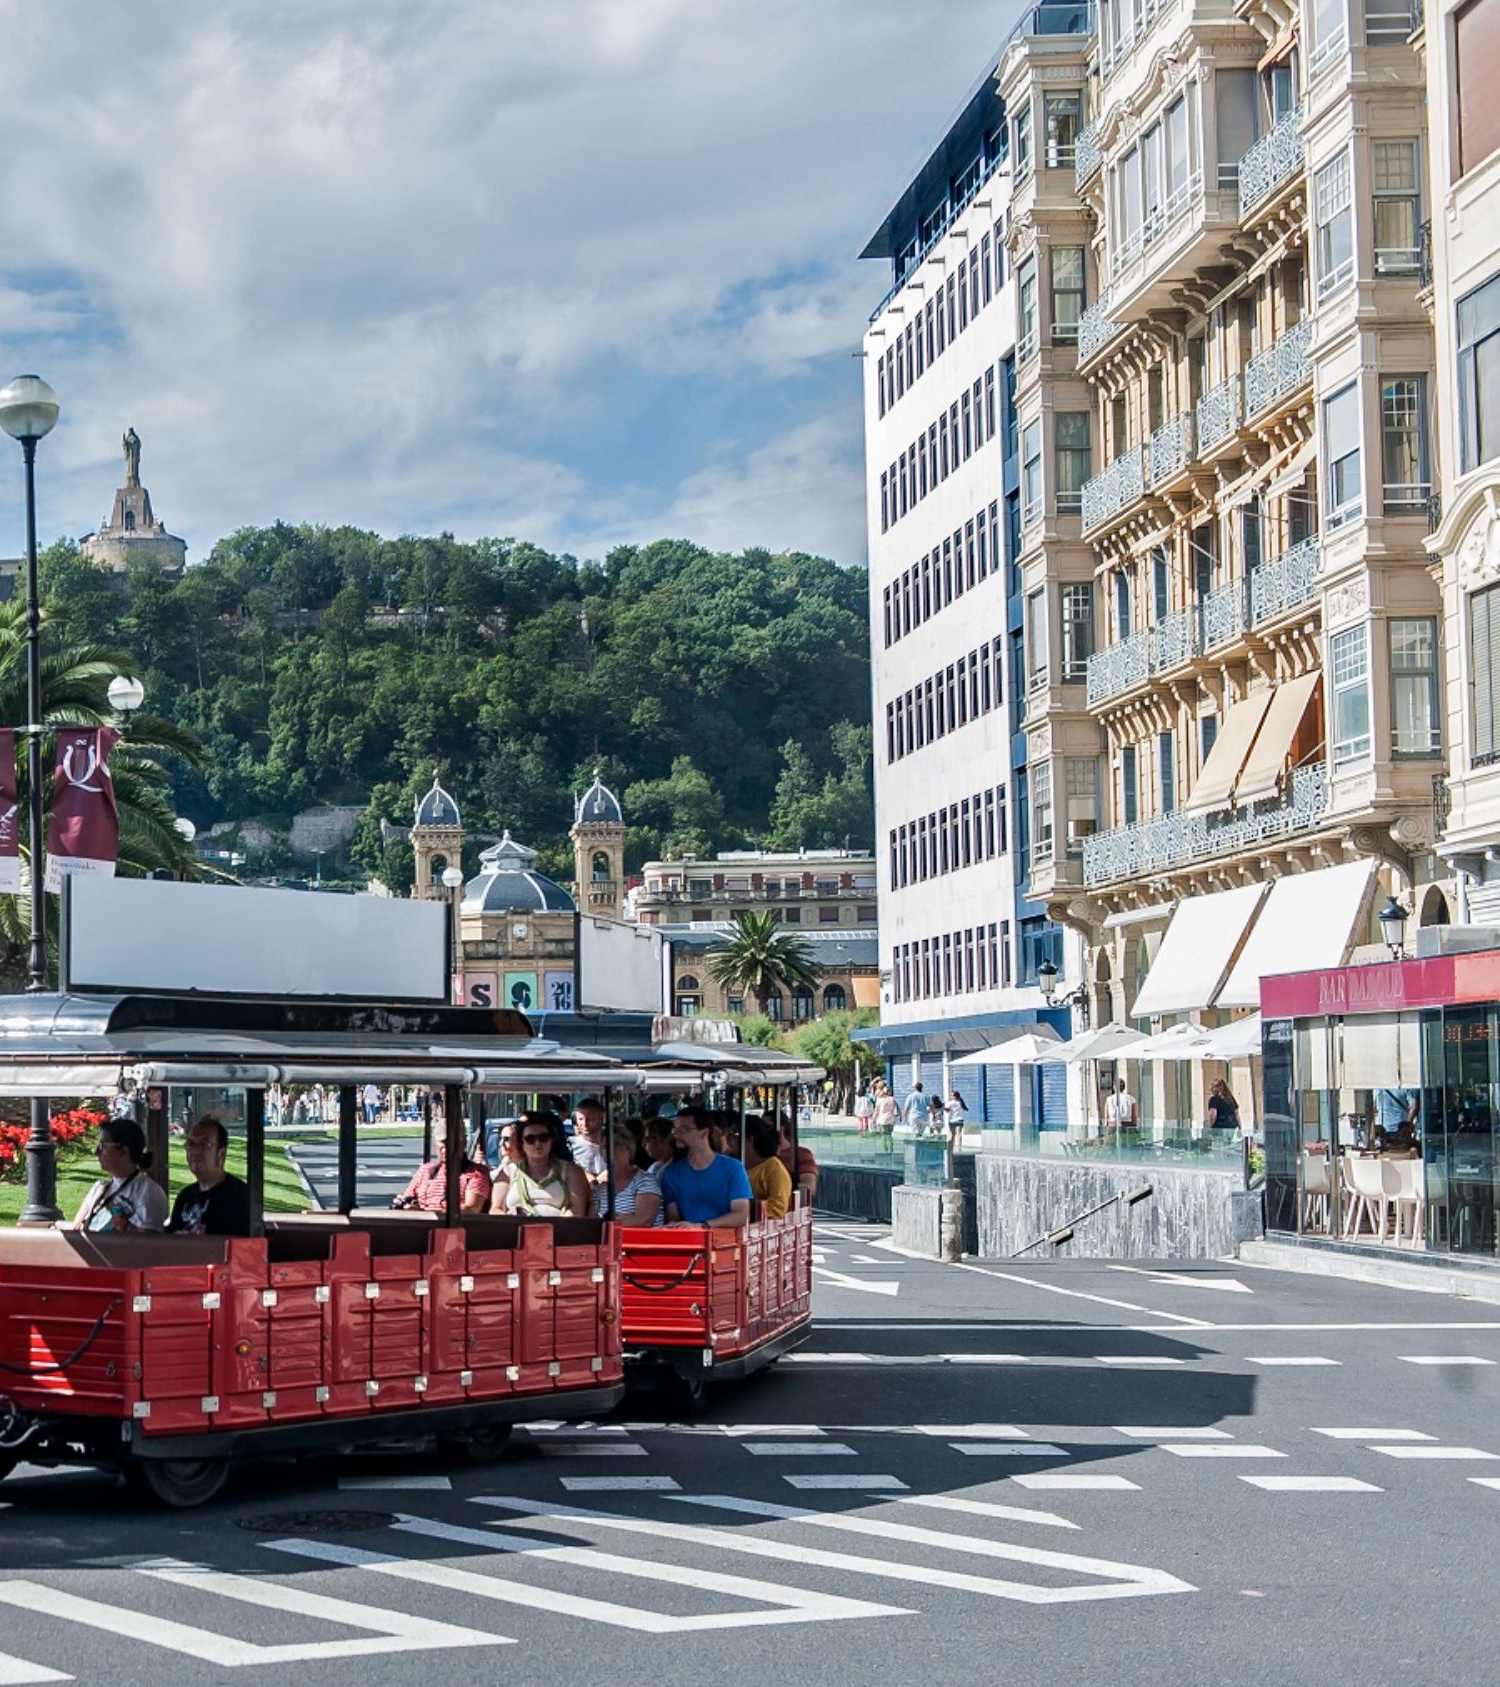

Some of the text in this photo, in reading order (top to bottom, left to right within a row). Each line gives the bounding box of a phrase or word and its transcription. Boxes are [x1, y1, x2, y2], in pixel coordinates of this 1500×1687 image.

[470, 984, 492, 1008] S
[551, 980, 571, 996] 20
[1319, 974, 1347, 1004] BAR
[553, 995, 571, 1010] 16
